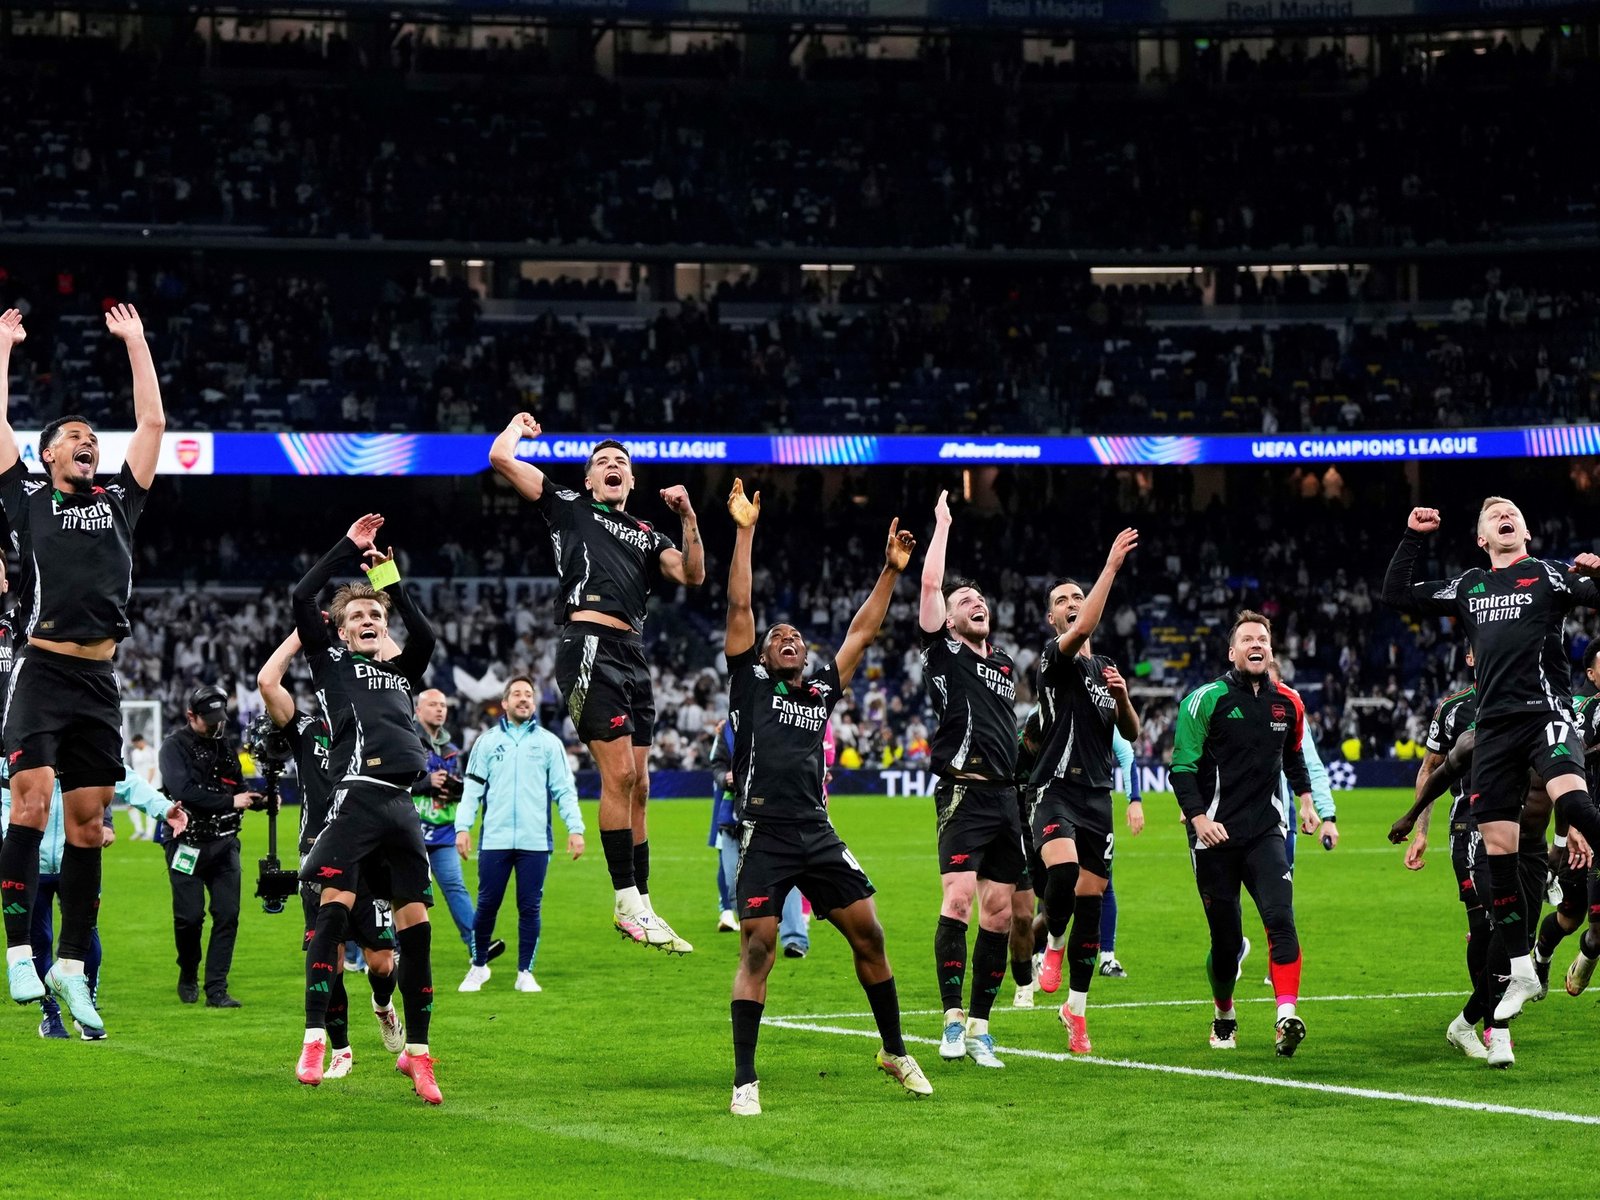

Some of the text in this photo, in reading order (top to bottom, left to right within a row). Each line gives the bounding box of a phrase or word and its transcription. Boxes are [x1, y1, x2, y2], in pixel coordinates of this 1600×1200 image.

[1227, 1, 1352, 18] Real Madrid
[660, 441, 727, 458] LEAGUE
[1252, 436, 1477, 458] UEFA CHAMPIONS LEAGUE
[62, 515, 112, 531] FLY BETTER
[1468, 593, 1533, 613] Emirates
[1476, 606, 1521, 625] FLY BETTER
[368, 677, 384, 690] FLY
[772, 695, 828, 720] Emirate
[779, 712, 794, 725] FLY
[1544, 721, 1570, 747] 17
[2, 880, 25, 890] AFC
[312, 961, 333, 974] AFC
[943, 960, 963, 968] AFC
